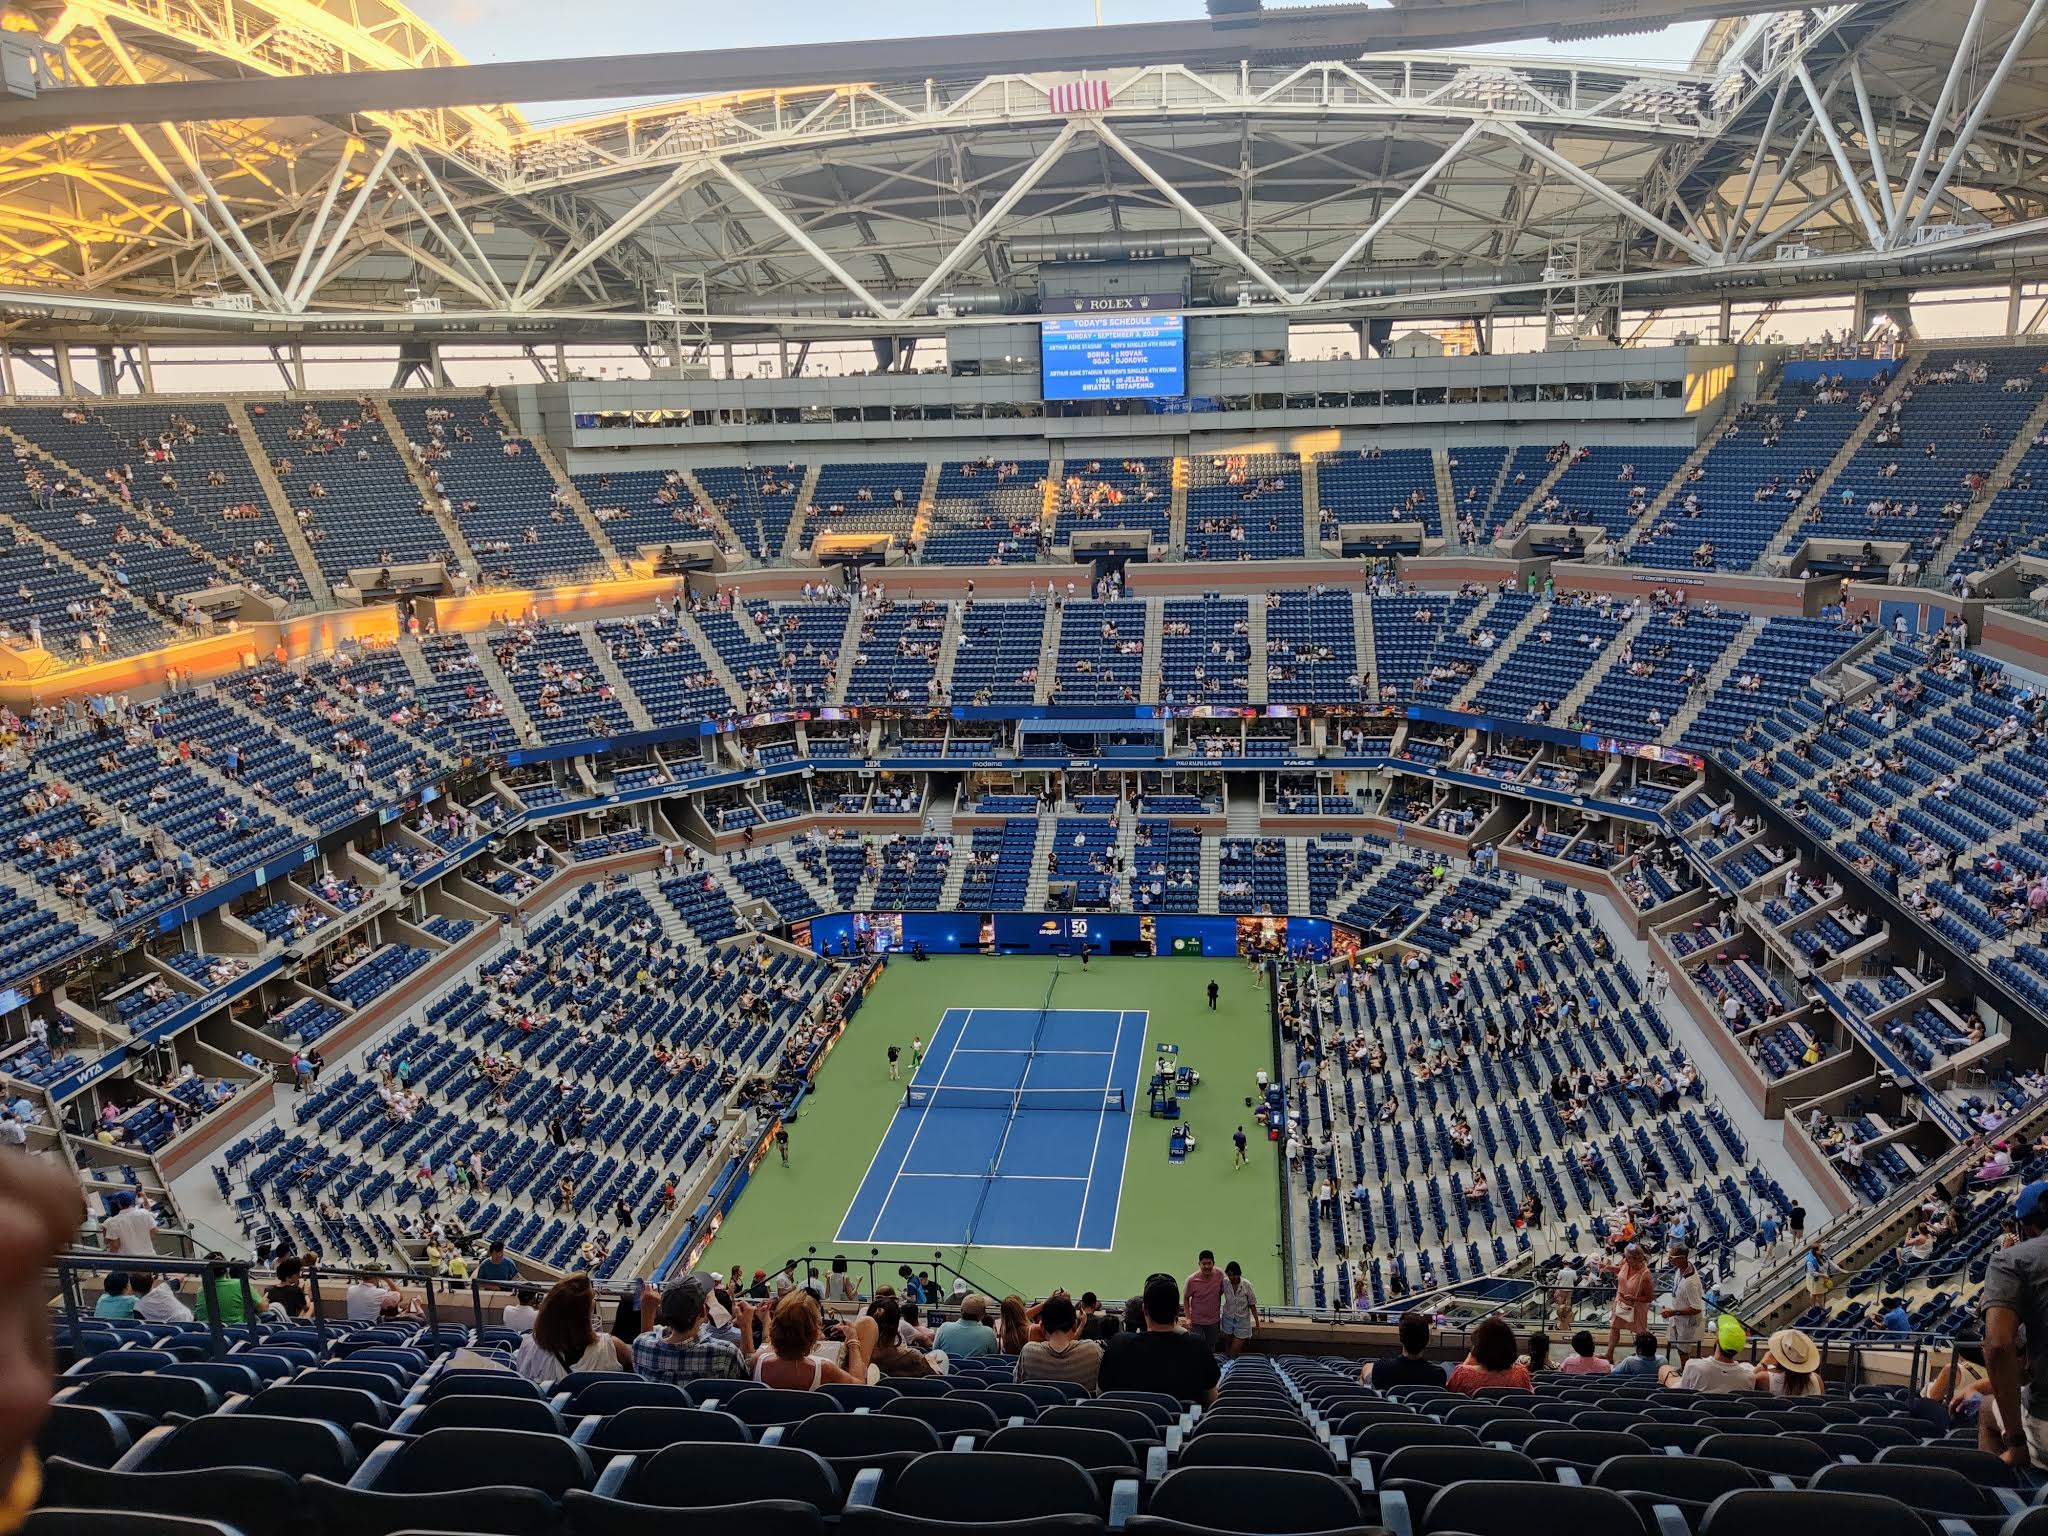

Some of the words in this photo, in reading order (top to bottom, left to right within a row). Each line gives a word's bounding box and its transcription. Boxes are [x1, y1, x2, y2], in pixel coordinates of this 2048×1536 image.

[1090, 298, 1133, 310] ROLEX
[1073, 319, 1108, 327] TODAY'S
[1109, 317, 1152, 326] SCHEDULE
[1097, 331, 1134, 339] SEPTEMBER
[1116, 382, 1154, 390] OSTAPENKO
[864, 760, 881, 768] IBM
[1500, 782, 1526, 794] CHASE
[443, 852, 461, 868] CHASE
[1071, 921, 1088, 933] 50
[76, 1062, 104, 1084] WTA
